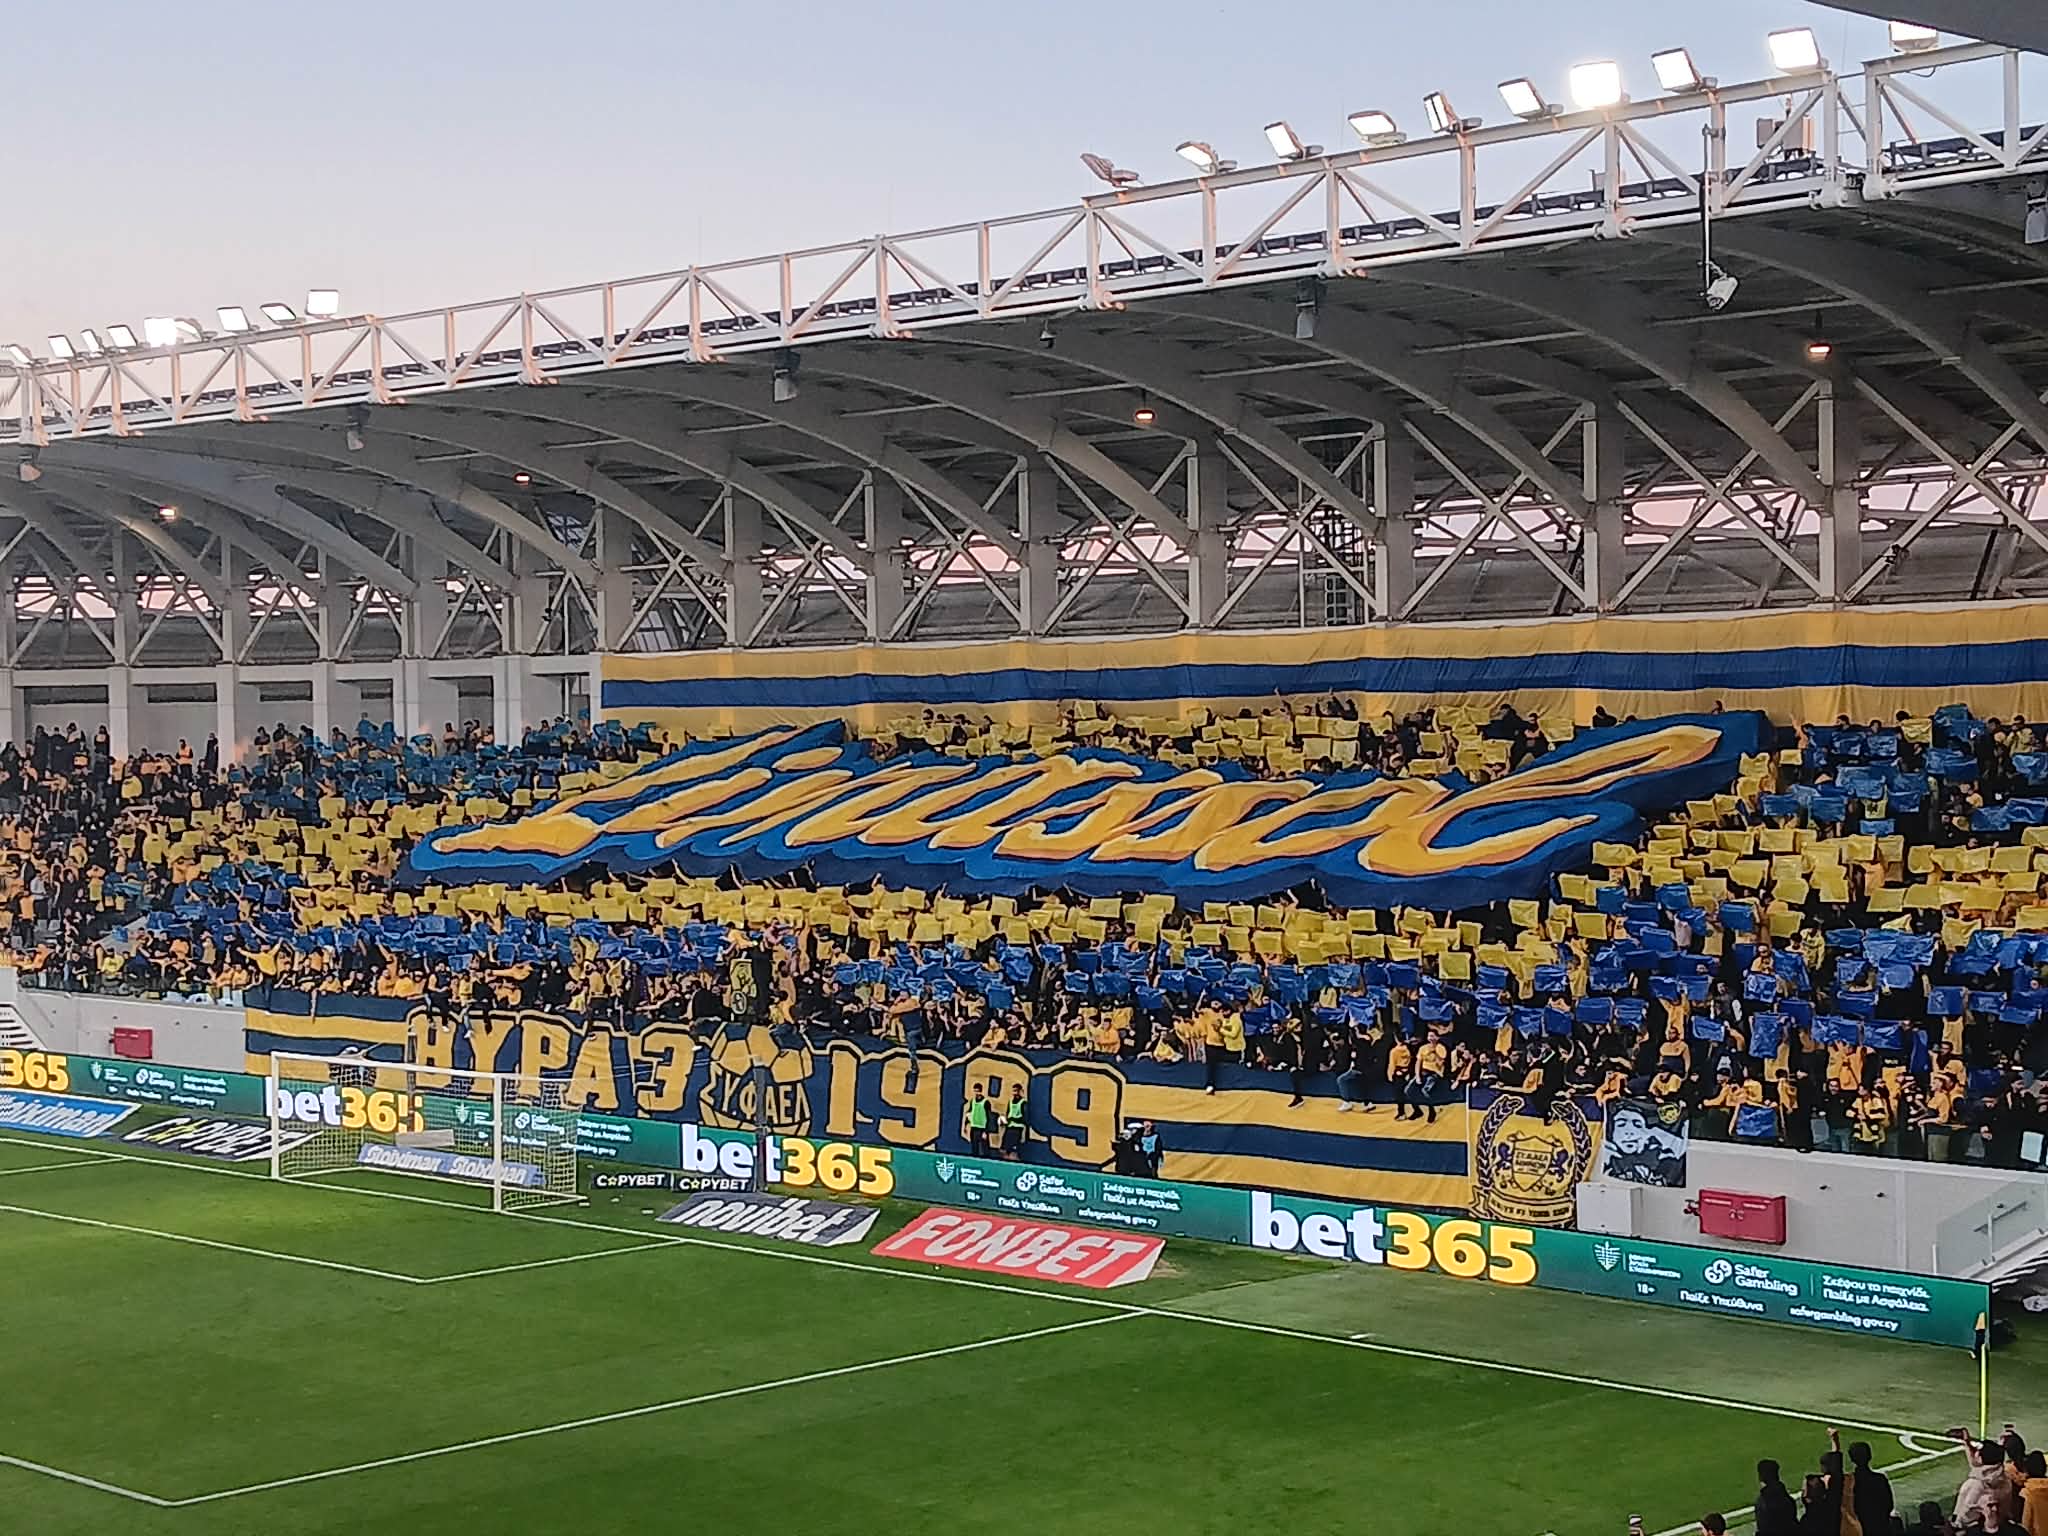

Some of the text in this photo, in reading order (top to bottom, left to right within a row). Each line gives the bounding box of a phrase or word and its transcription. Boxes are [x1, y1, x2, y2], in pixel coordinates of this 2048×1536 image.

[825, 1048, 1119, 1165] 1989
[681, 1124, 895, 1197] bet365
[1039, 1184, 1085, 1201] Gambling
[679, 1198, 856, 1244] novibet
[889, 1214, 1148, 1280] FONBET
[1251, 1190, 1538, 1286] bet365
[1734, 1263, 1771, 1278] Safer
[1735, 1275, 1799, 1296] Gambling
